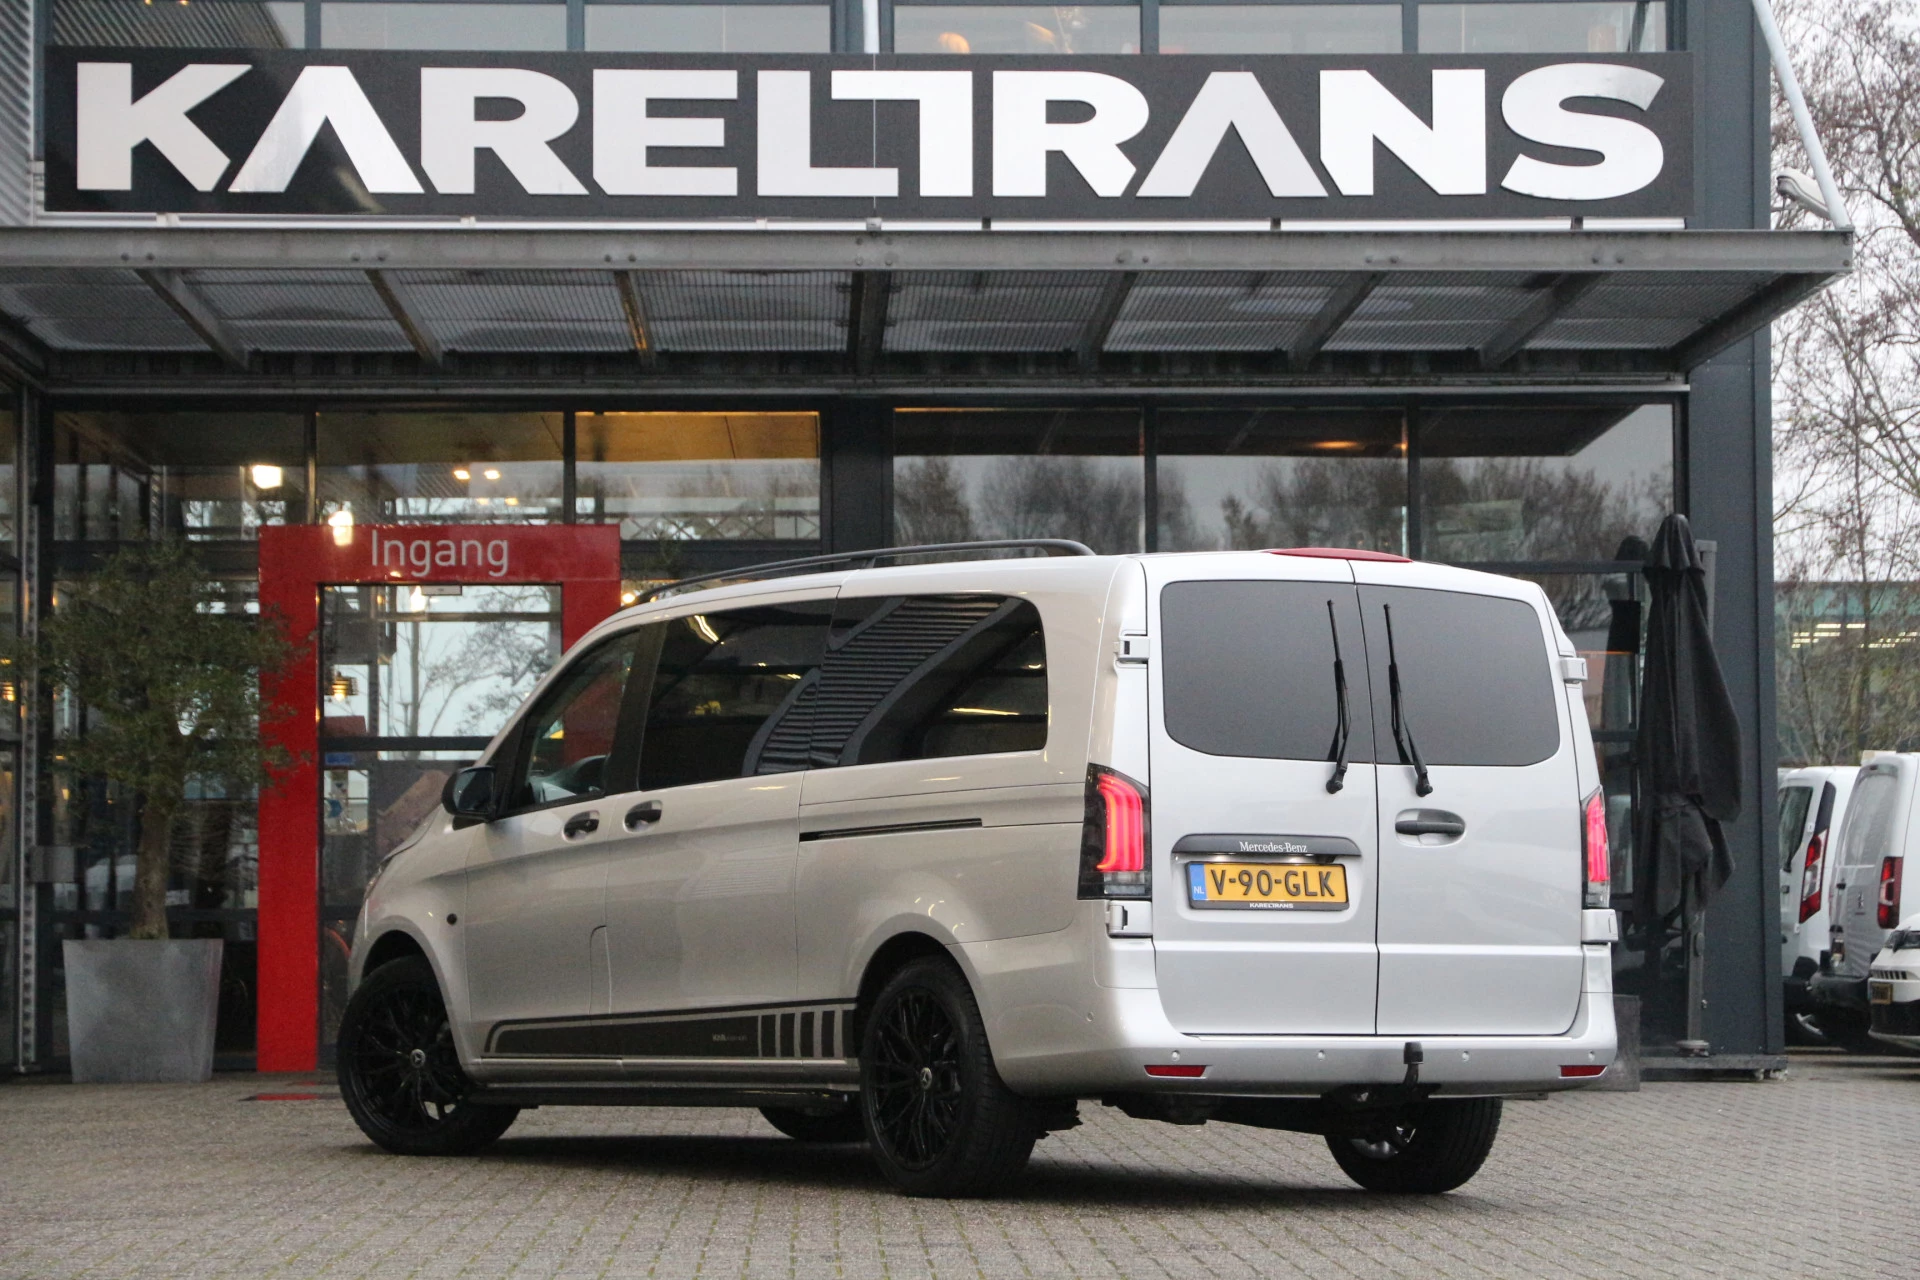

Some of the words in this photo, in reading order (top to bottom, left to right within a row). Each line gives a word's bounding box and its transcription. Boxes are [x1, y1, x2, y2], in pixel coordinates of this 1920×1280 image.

[76, 61, 1665, 200] KARELTRANS
[371, 529, 509, 578] Ingang
[1239, 841, 1308, 853] Mercedes-Benz
[1193, 886, 1205, 895] NL
[1210, 869, 1336, 898] V-90-GLK
